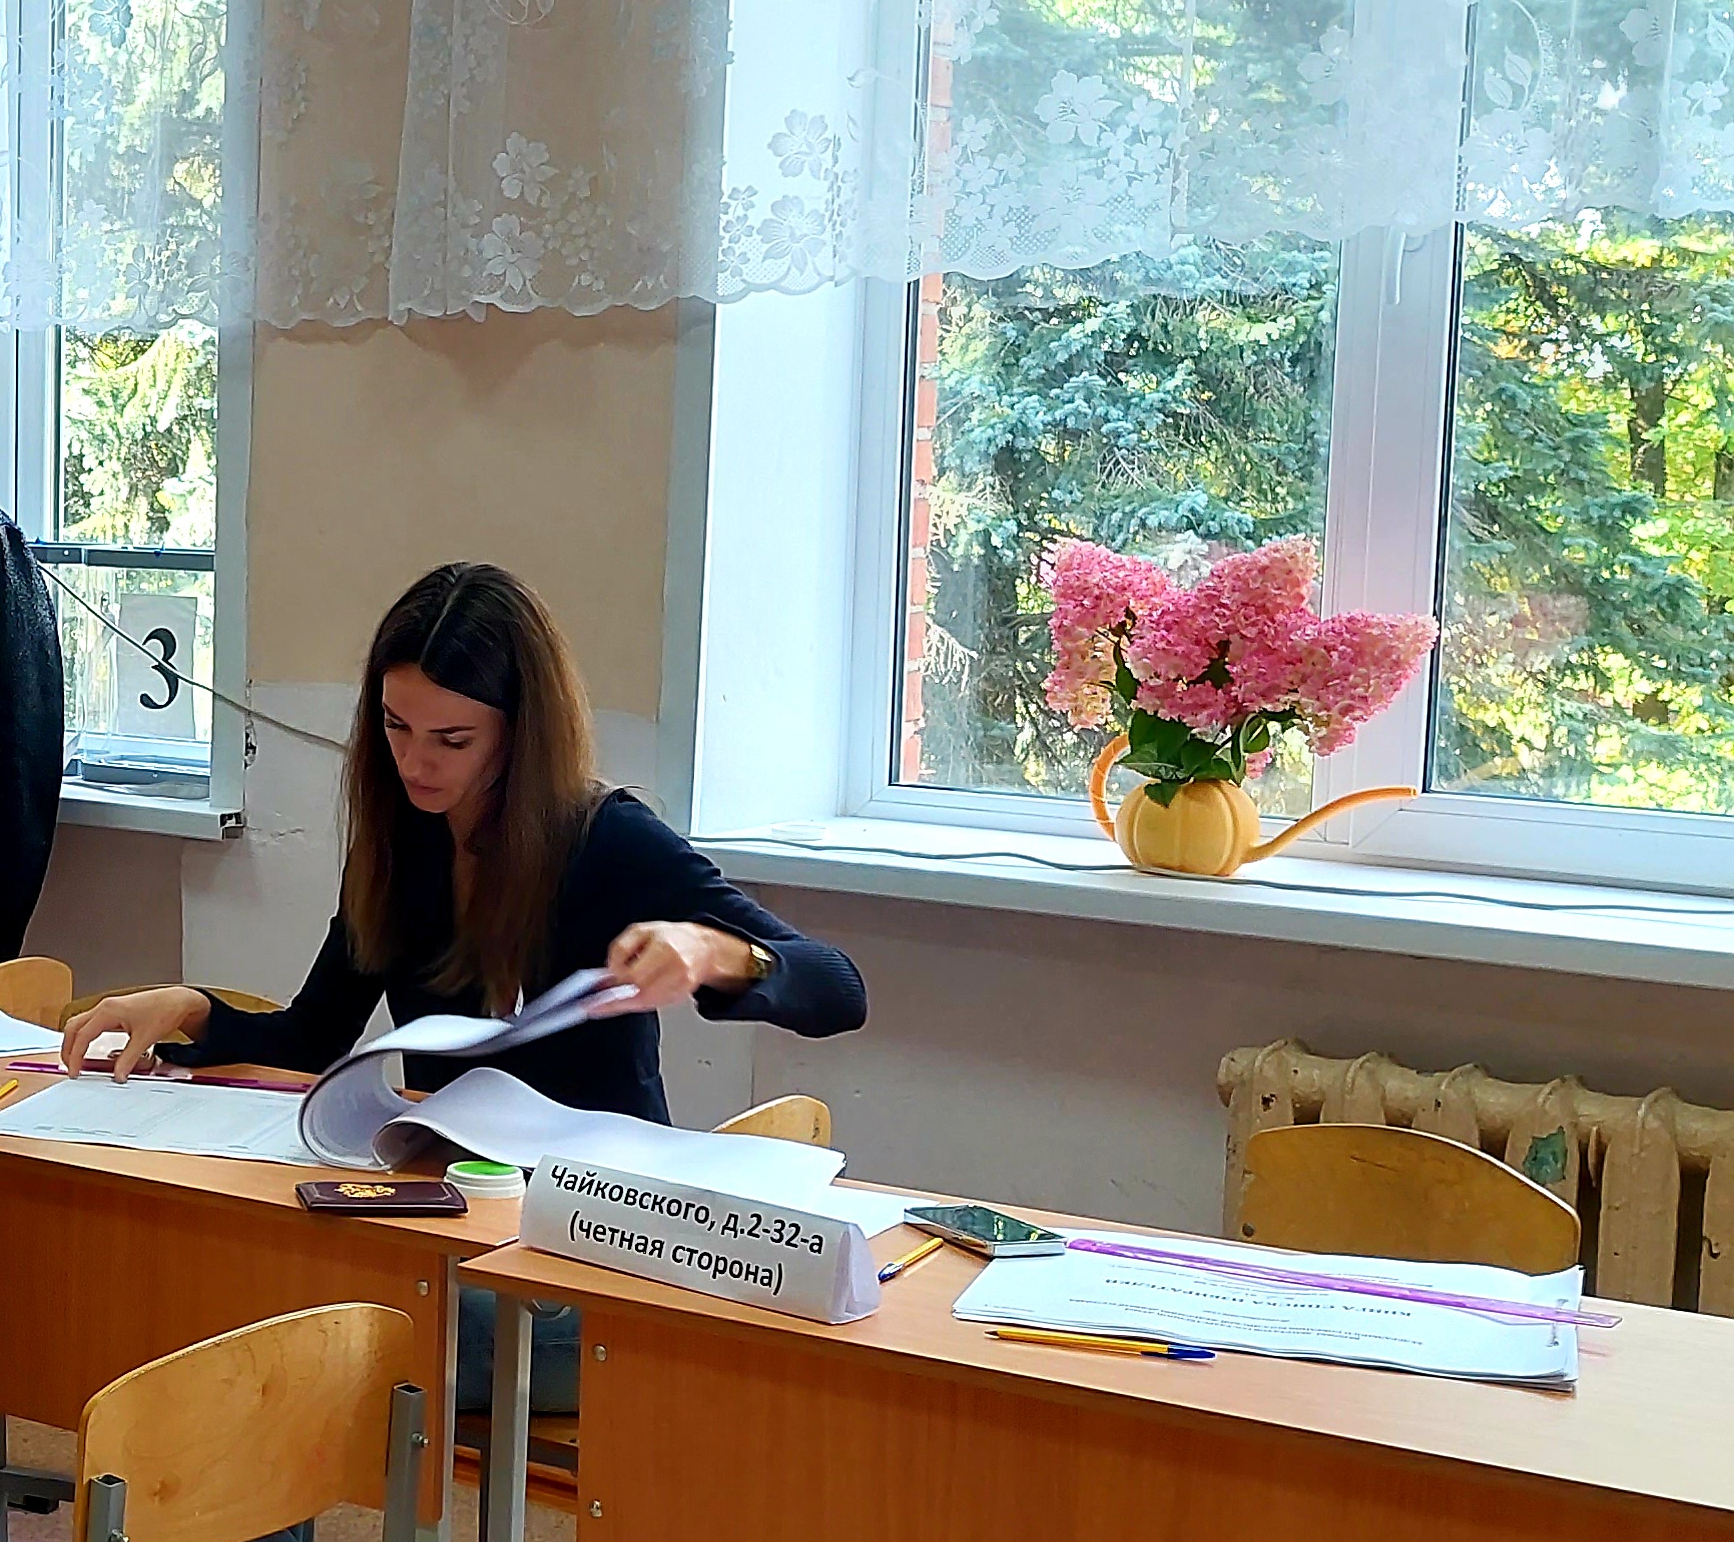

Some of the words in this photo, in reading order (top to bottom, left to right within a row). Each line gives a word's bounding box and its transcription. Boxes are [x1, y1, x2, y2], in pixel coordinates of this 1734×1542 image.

[139, 627, 179, 710] 3
[550, 1164, 716, 1231] Чайковского,
[720, 1212, 825, 1255] д.2-32-а
[568, 1210, 665, 1259] (четная
[670, 1243, 784, 1296] сторона)
